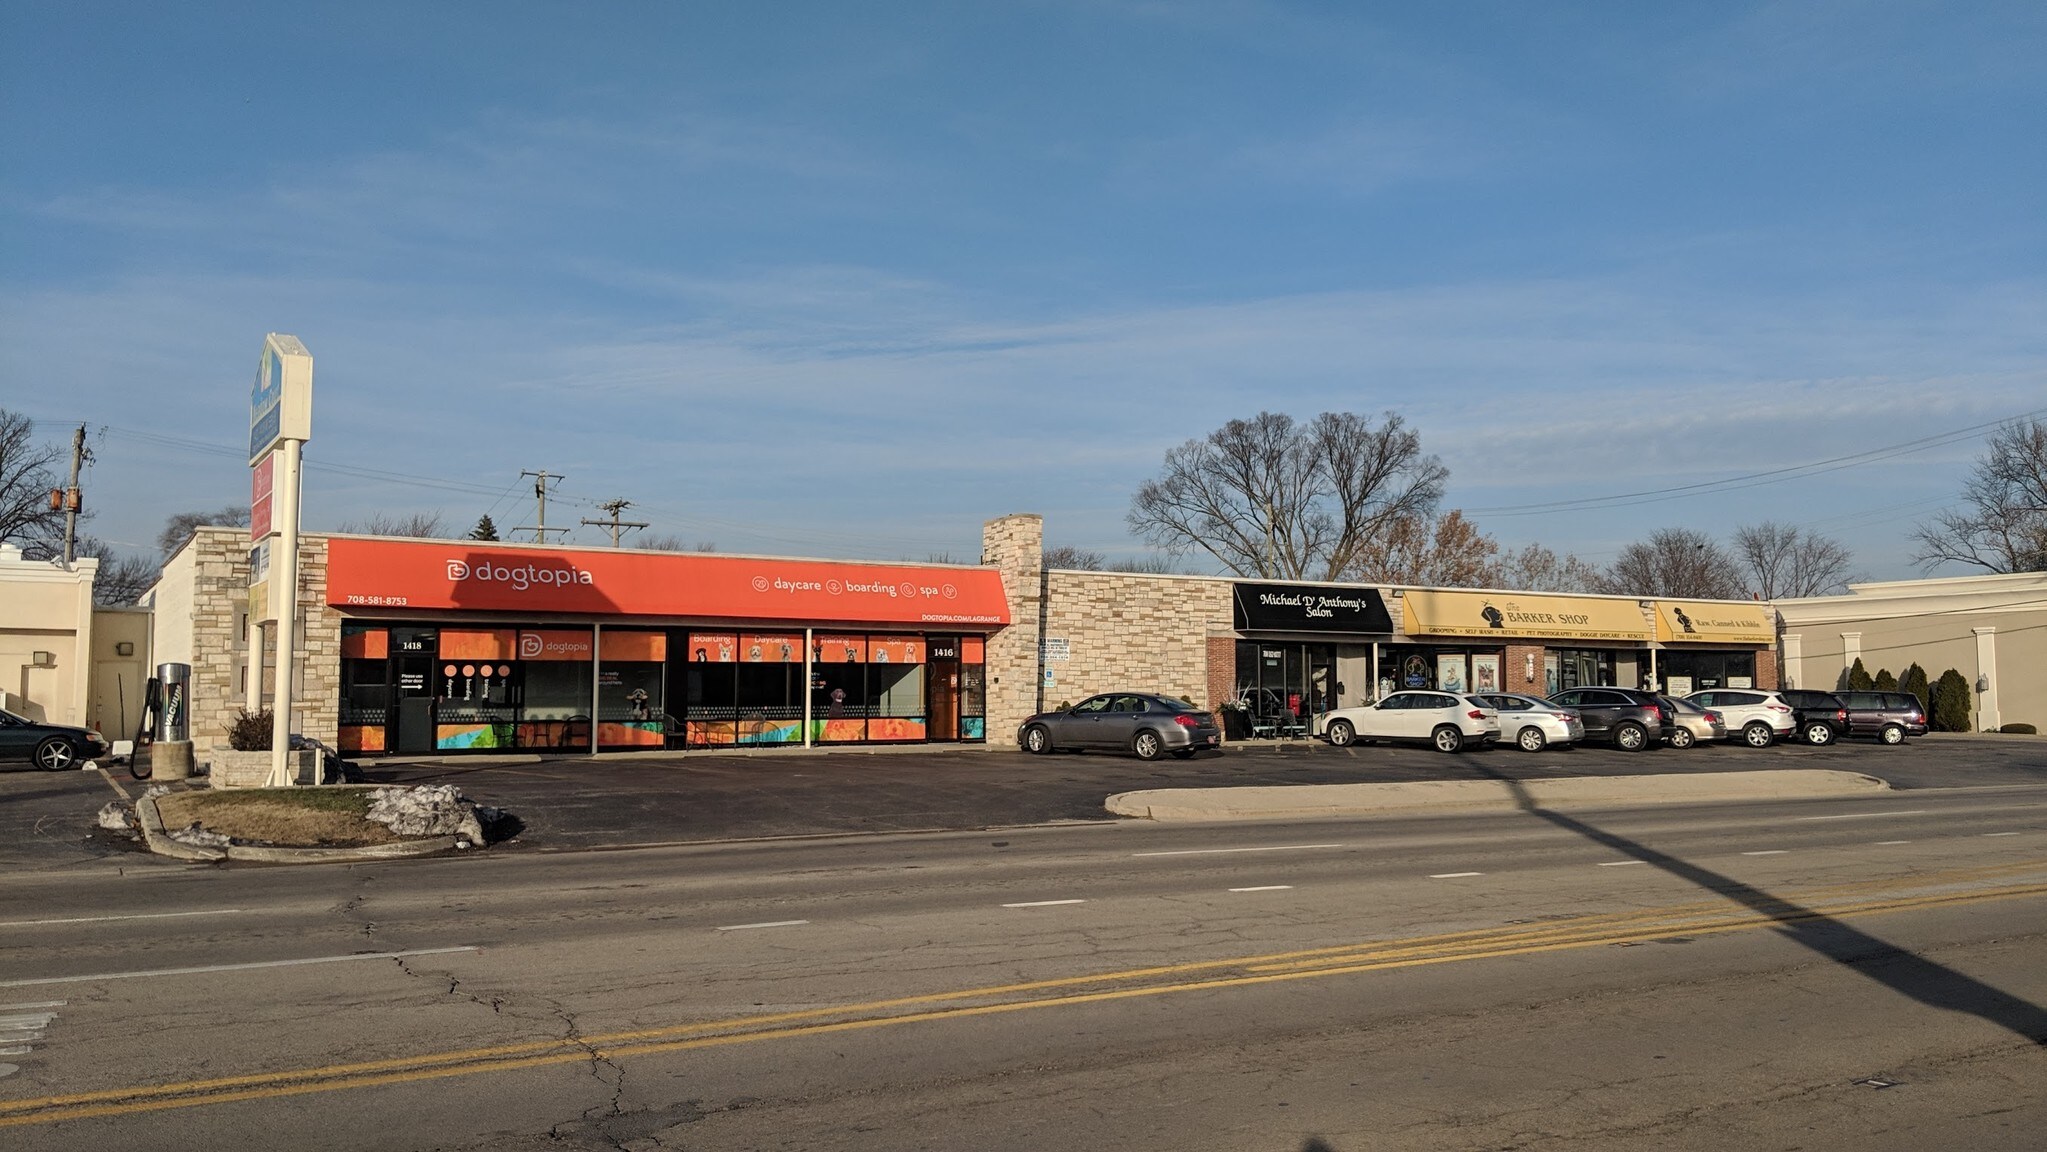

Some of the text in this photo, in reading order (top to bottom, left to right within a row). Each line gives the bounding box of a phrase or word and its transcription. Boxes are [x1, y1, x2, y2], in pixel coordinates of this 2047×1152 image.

[476, 562, 593, 590] dogtopia
[774, 577, 939, 598] daycare boarding spa
[347, 595, 407, 606] 708-581-8753
[1260, 593, 1302, 606] Michael
[1319, 596, 1367, 612] Anthony's
[1306, 605, 1333, 618] Salon
[922, 614, 1001, 623] DOGTOPIA.COM/LAGRANGE
[1507, 612, 1589, 625] BARKER SHOP
[1712, 620, 1736, 628] Canned
[1741, 620, 1761, 628] Kibble
[693, 634, 731, 645] Boarding
[754, 635, 789, 645] Daycare
[820, 636, 850, 646] Training
[886, 637, 901, 647] Spa
[403, 642, 422, 650] 1418
[546, 642, 588, 654] dogtopia
[934, 648, 954, 657] 1416
[165, 684, 182, 726] VACUUM
